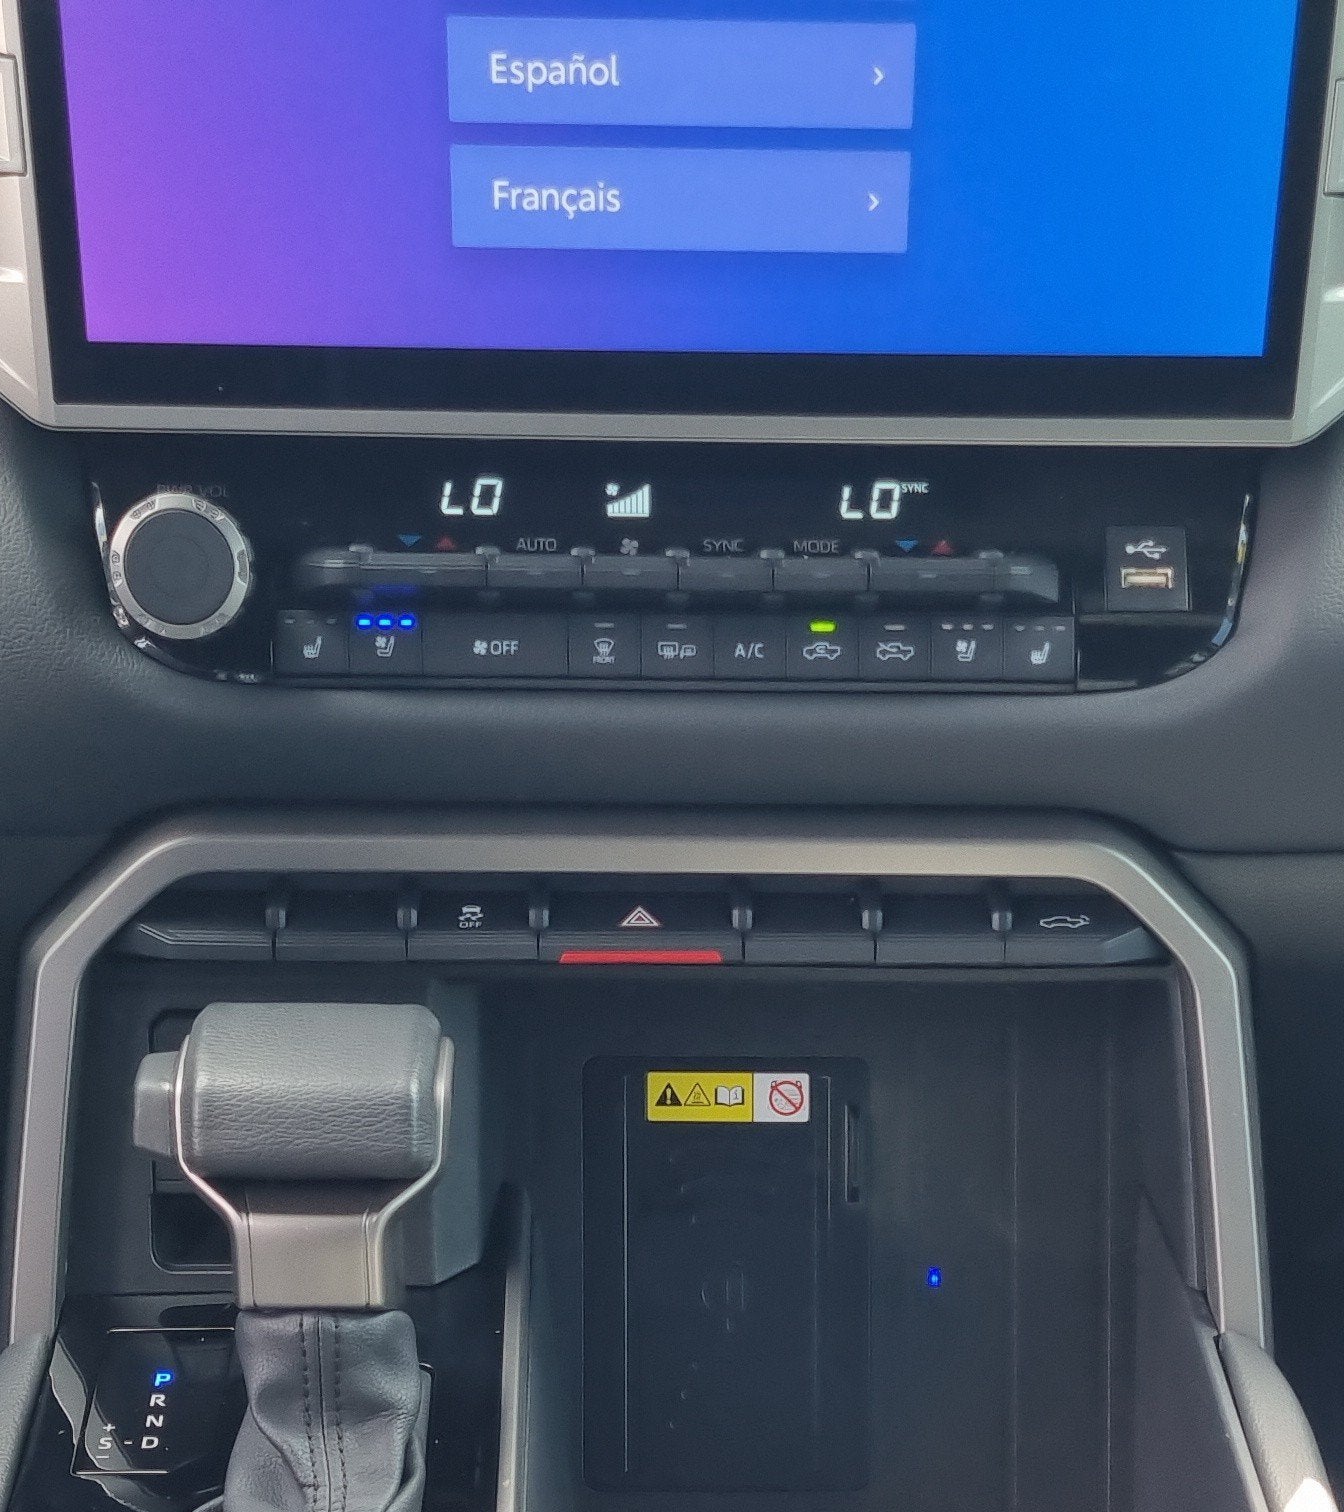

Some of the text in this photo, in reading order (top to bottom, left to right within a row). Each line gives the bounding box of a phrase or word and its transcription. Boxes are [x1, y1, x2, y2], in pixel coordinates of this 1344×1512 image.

[490, 53, 620, 93] Español
[492, 180, 622, 220] Français
[440, 477, 504, 516] LO
[839, 480, 929, 520] LO SYNC
[516, 537, 557, 552] AUTO
[703, 538, 745, 552] SYNC
[793, 540, 840, 554] MODE
[490, 640, 519, 656] OFF
[734, 643, 765, 659] A/C
[459, 921, 483, 929] OFF
[154, 1373, 171, 1387] P
[149, 1393, 166, 1407] R
[145, 1414, 164, 1428] N
[98, 1436, 159, 1449] S D
